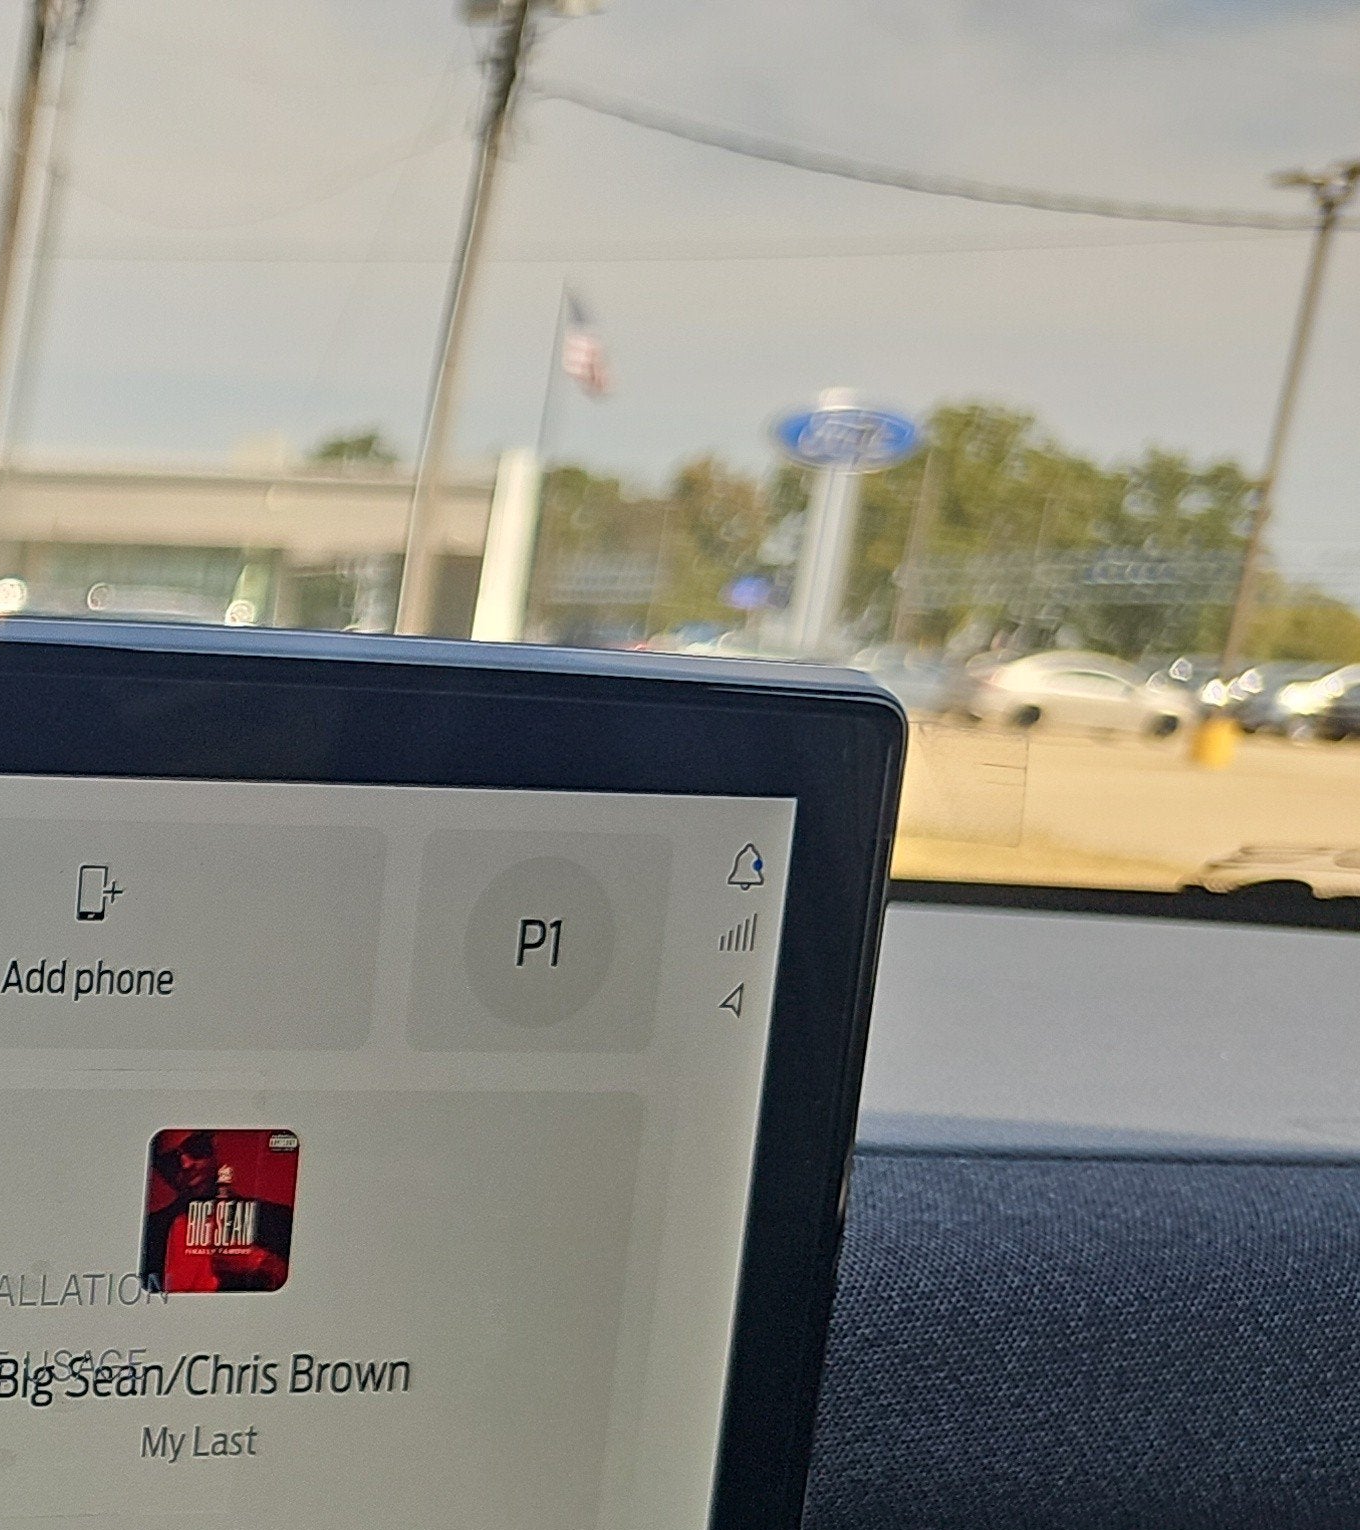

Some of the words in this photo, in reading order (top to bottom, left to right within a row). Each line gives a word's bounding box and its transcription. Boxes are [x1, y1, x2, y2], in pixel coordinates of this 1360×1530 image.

[514, 917, 565, 968] P1
[0, 959, 66, 996] Add
[73, 960, 175, 1002] phone
[186, 1200, 214, 1247] BIG
[214, 1200, 258, 1247] SEAN
[65, 1353, 279, 1398] Sean/Chris
[288, 1352, 411, 1395] Brown
[141, 1426, 186, 1464] My
[192, 1425, 258, 1457] Last
